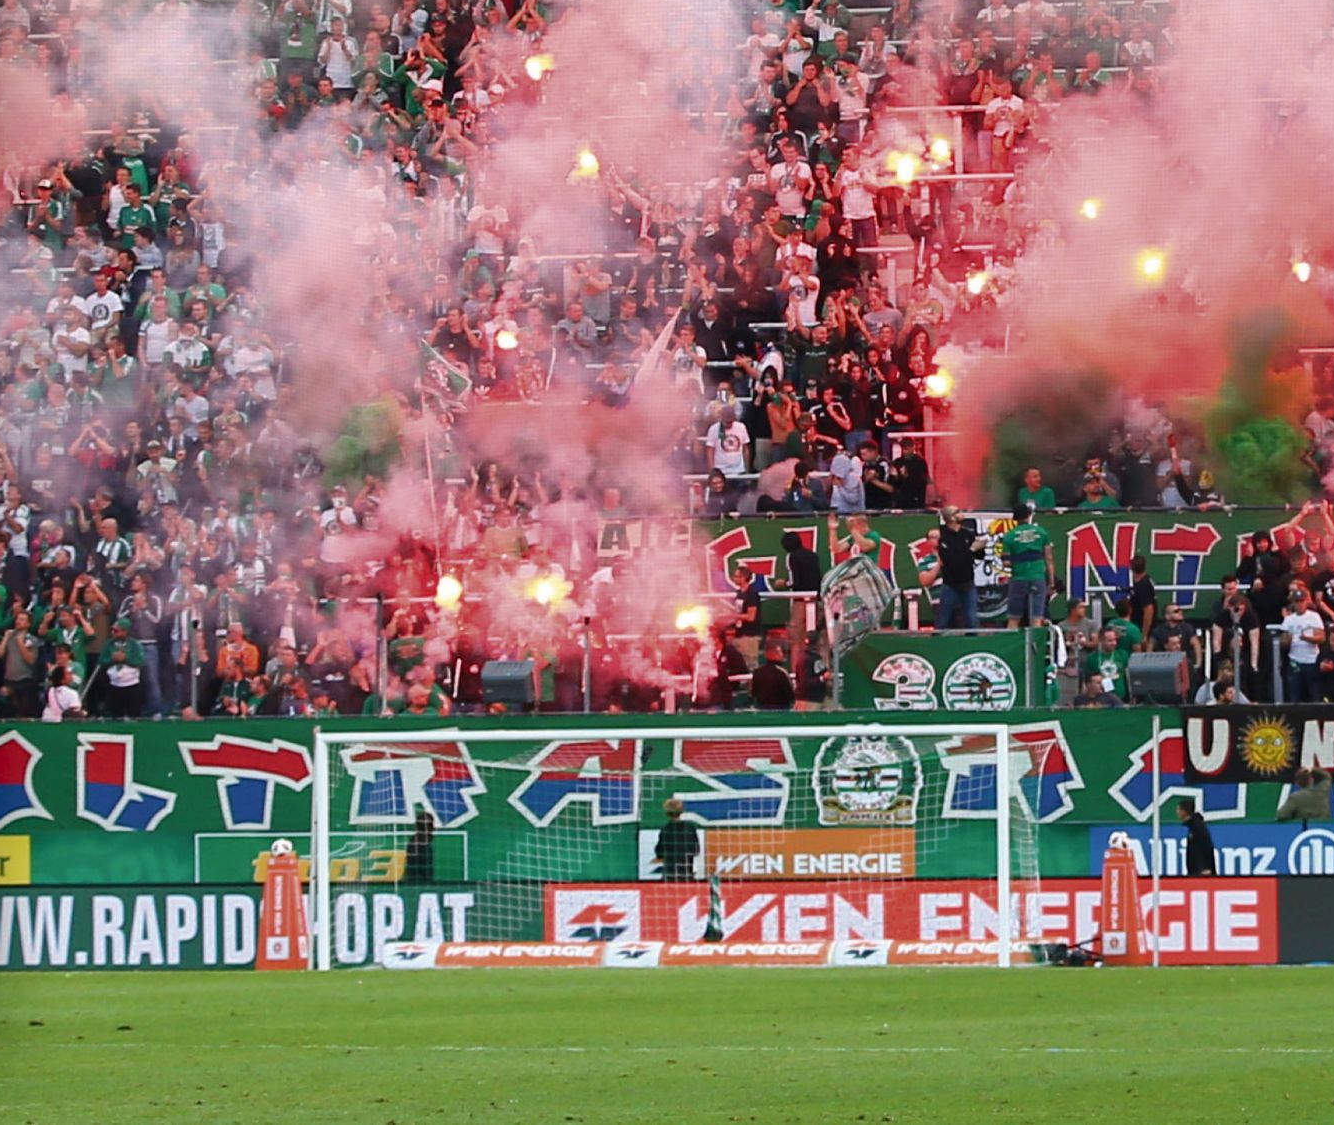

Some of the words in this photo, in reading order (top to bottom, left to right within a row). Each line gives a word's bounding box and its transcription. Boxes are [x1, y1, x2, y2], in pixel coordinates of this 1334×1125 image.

[716, 853, 783, 874] WIEN
[793, 852, 902, 874] ENERGIE
[1128, 837, 1278, 876] Allinz
[678, 893, 884, 943] WIEN
[445, 945, 501, 957] WIEN
[503, 945, 597, 957] ENERGIE
[669, 943, 726, 955] WIEN
[727, 943, 823, 956] ENERGIE
[897, 943, 954, 955] WIEN
